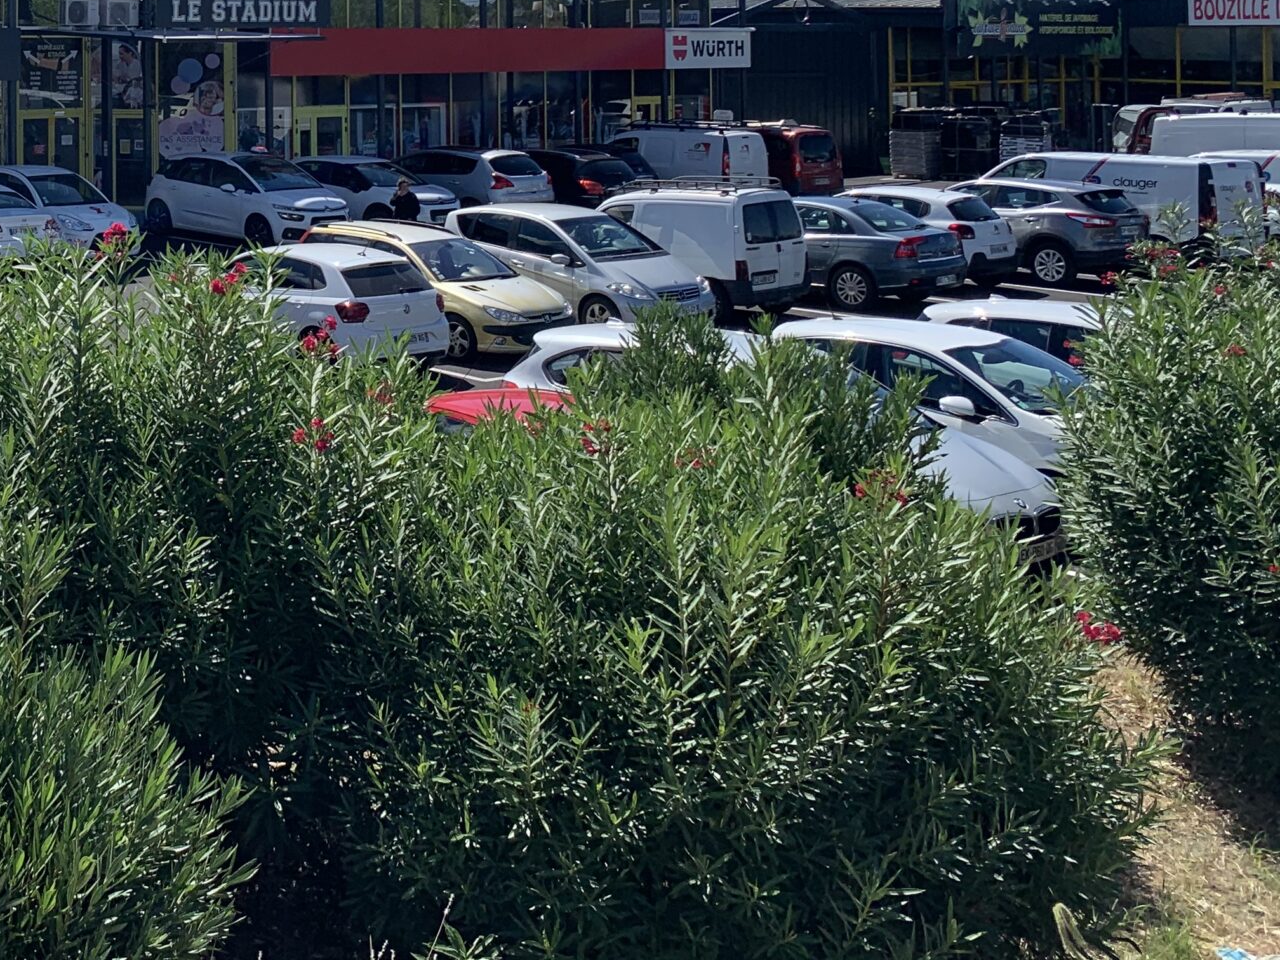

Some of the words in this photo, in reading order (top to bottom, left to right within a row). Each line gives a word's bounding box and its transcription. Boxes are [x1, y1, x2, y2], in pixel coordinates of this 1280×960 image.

[172, 0, 201, 22] LE
[212, 0, 317, 22] STADIUM
[691, 40, 745, 57] WÜRTH
[1113, 177, 1158, 190] clauger
